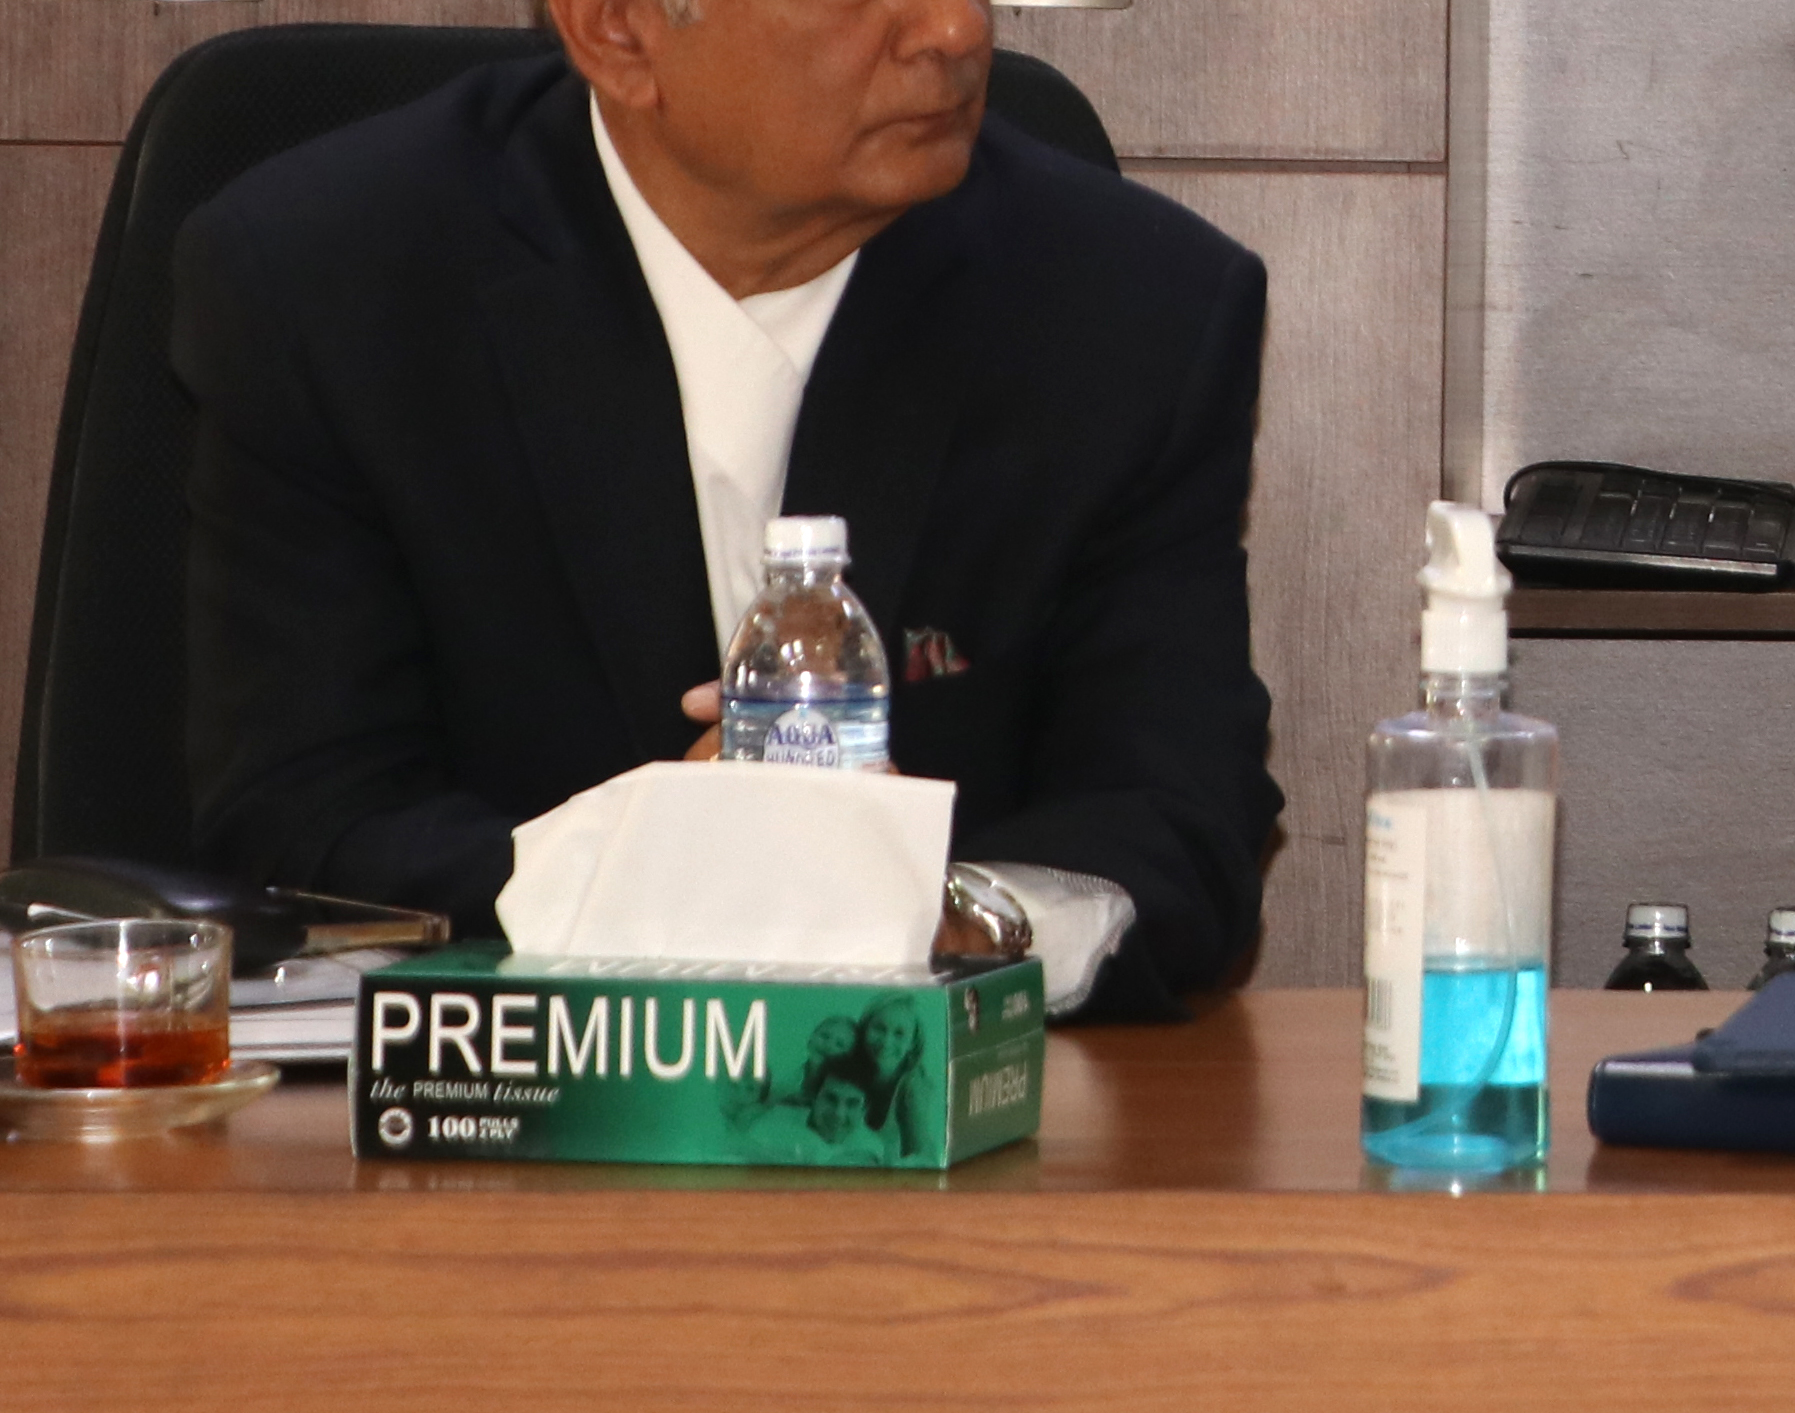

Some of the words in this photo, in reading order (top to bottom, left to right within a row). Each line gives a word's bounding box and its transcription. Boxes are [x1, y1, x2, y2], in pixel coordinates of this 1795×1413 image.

[371, 991, 769, 1082] PREMIUM
[369, 1077, 406, 1101] the
[412, 1081, 489, 1099] PREMIUM
[493, 1081, 560, 1103] tissue
[428, 1116, 476, 1139] 100
